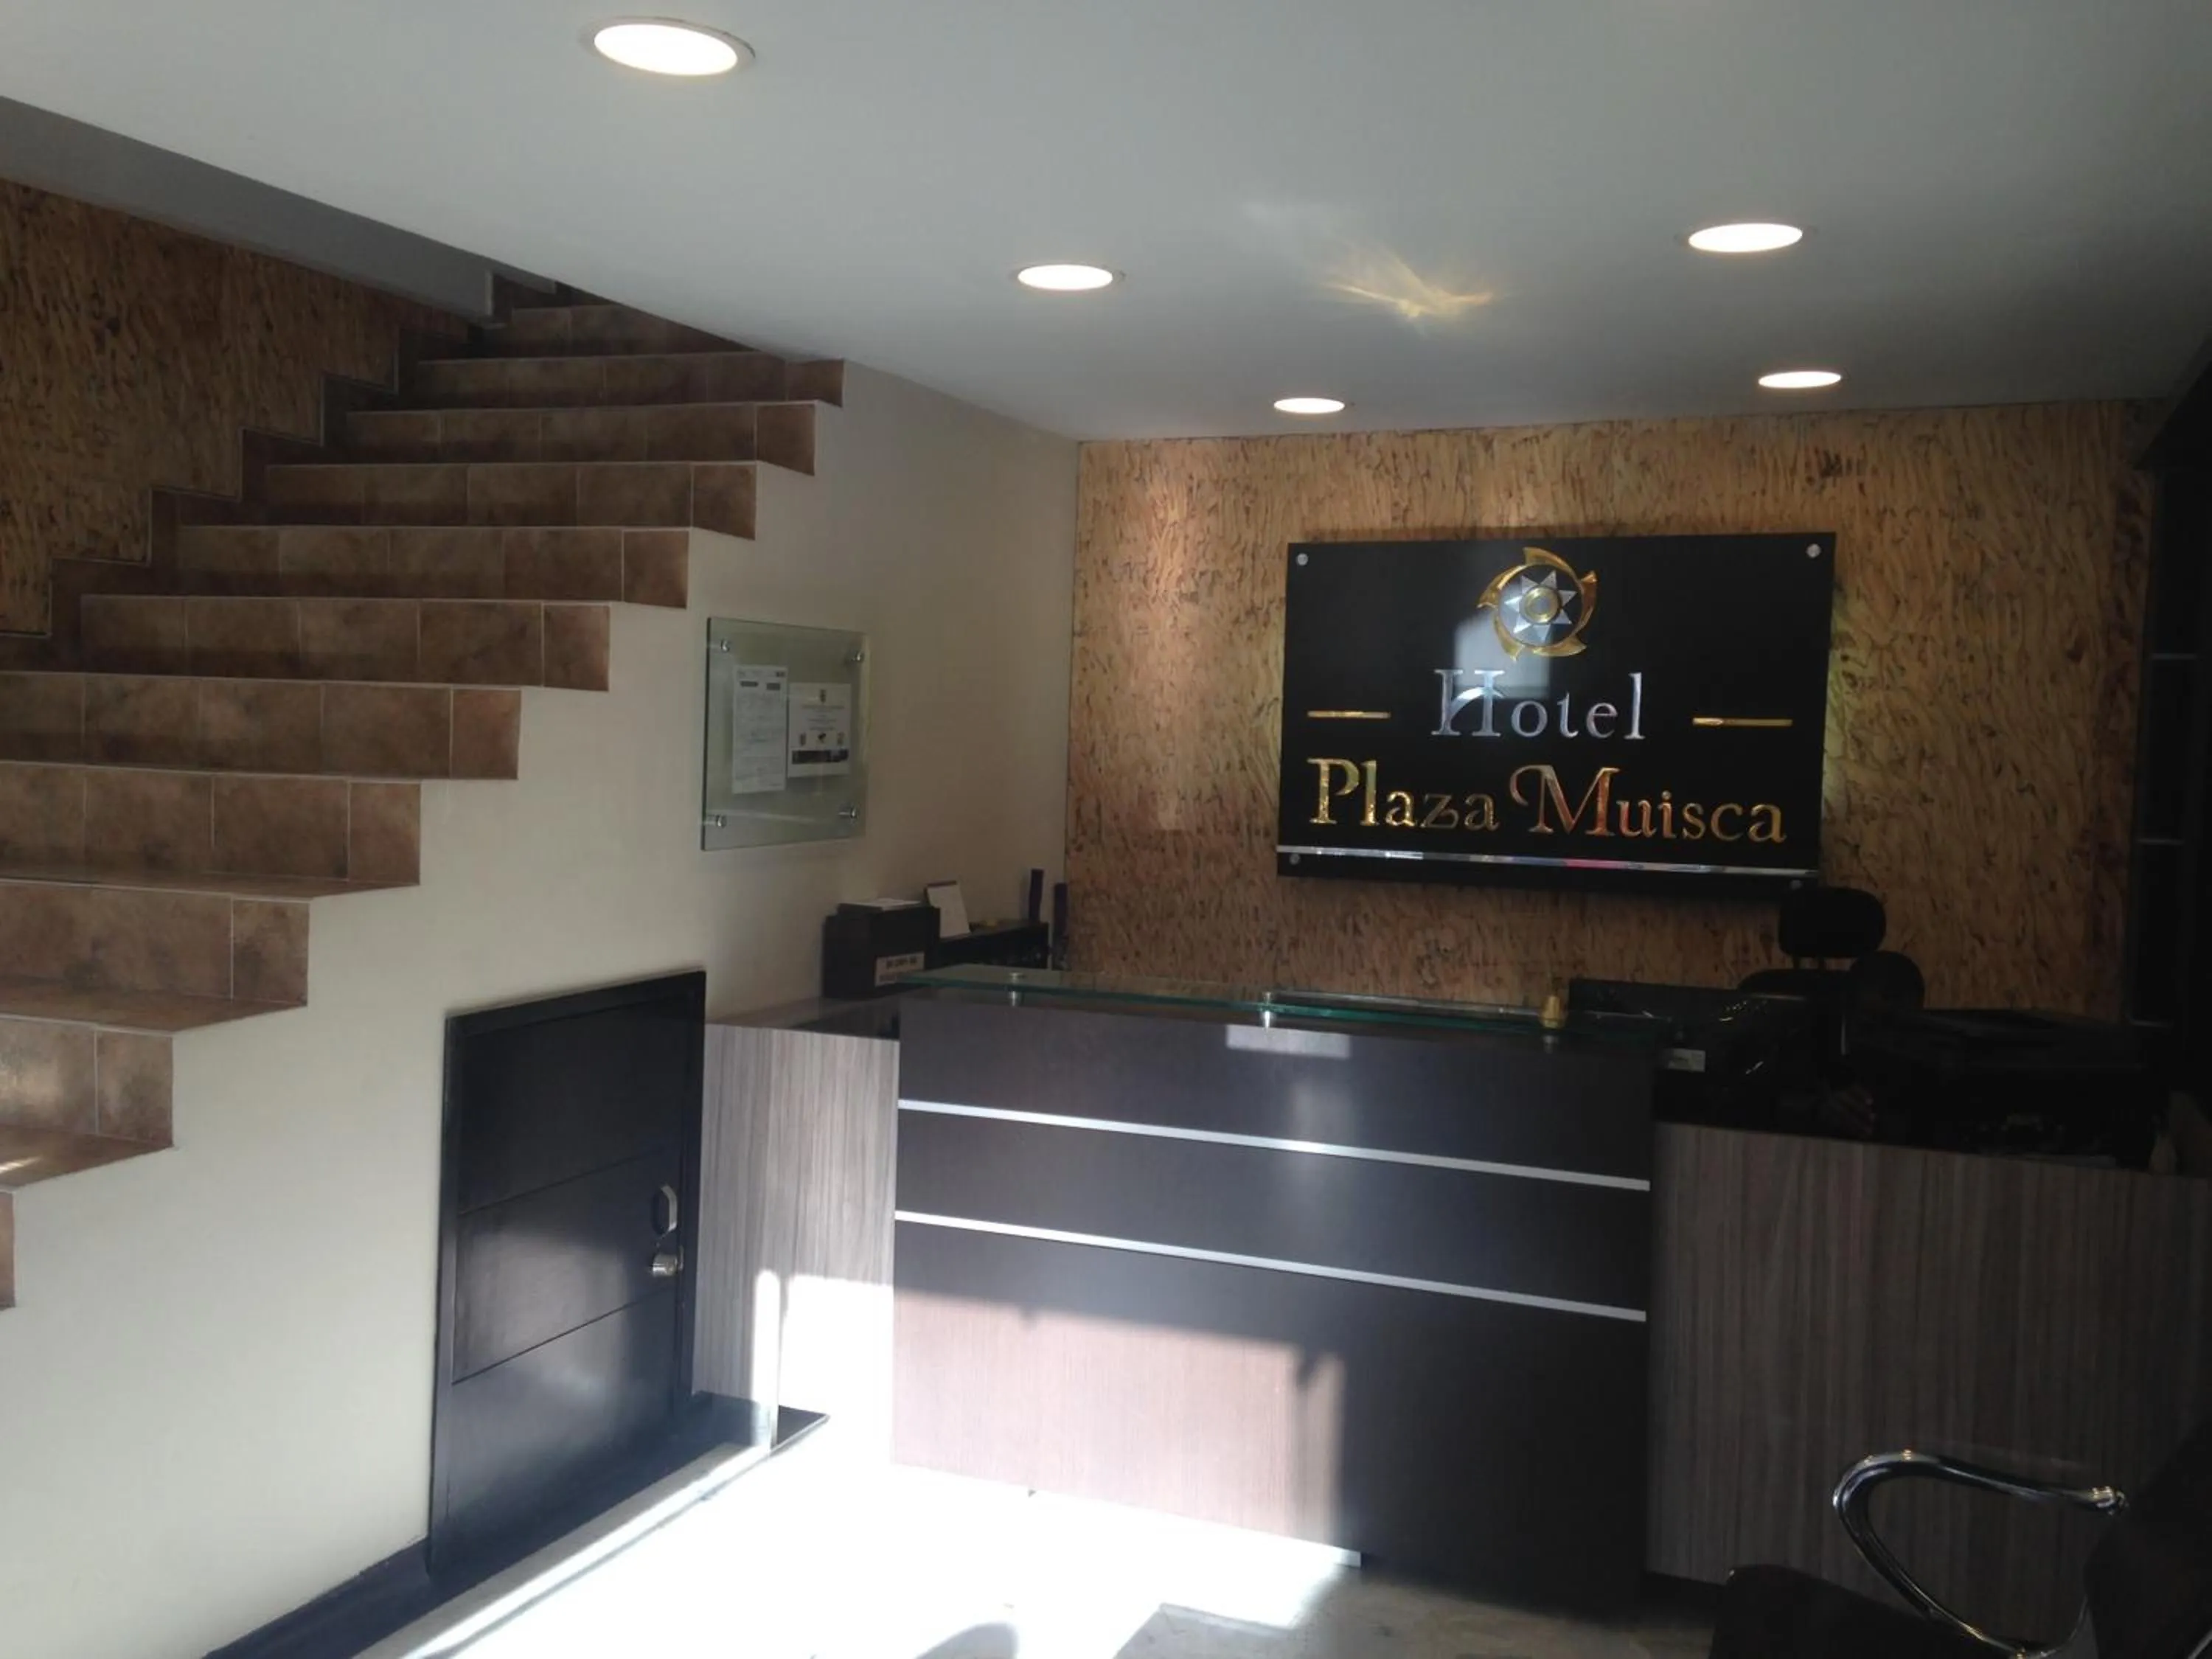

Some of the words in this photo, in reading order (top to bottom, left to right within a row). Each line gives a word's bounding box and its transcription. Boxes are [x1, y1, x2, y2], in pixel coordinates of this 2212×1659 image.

[1431, 668, 1646, 740] Hotel
[1307, 758, 1500, 831] Plaza
[1510, 765, 1787, 843] Muisca
